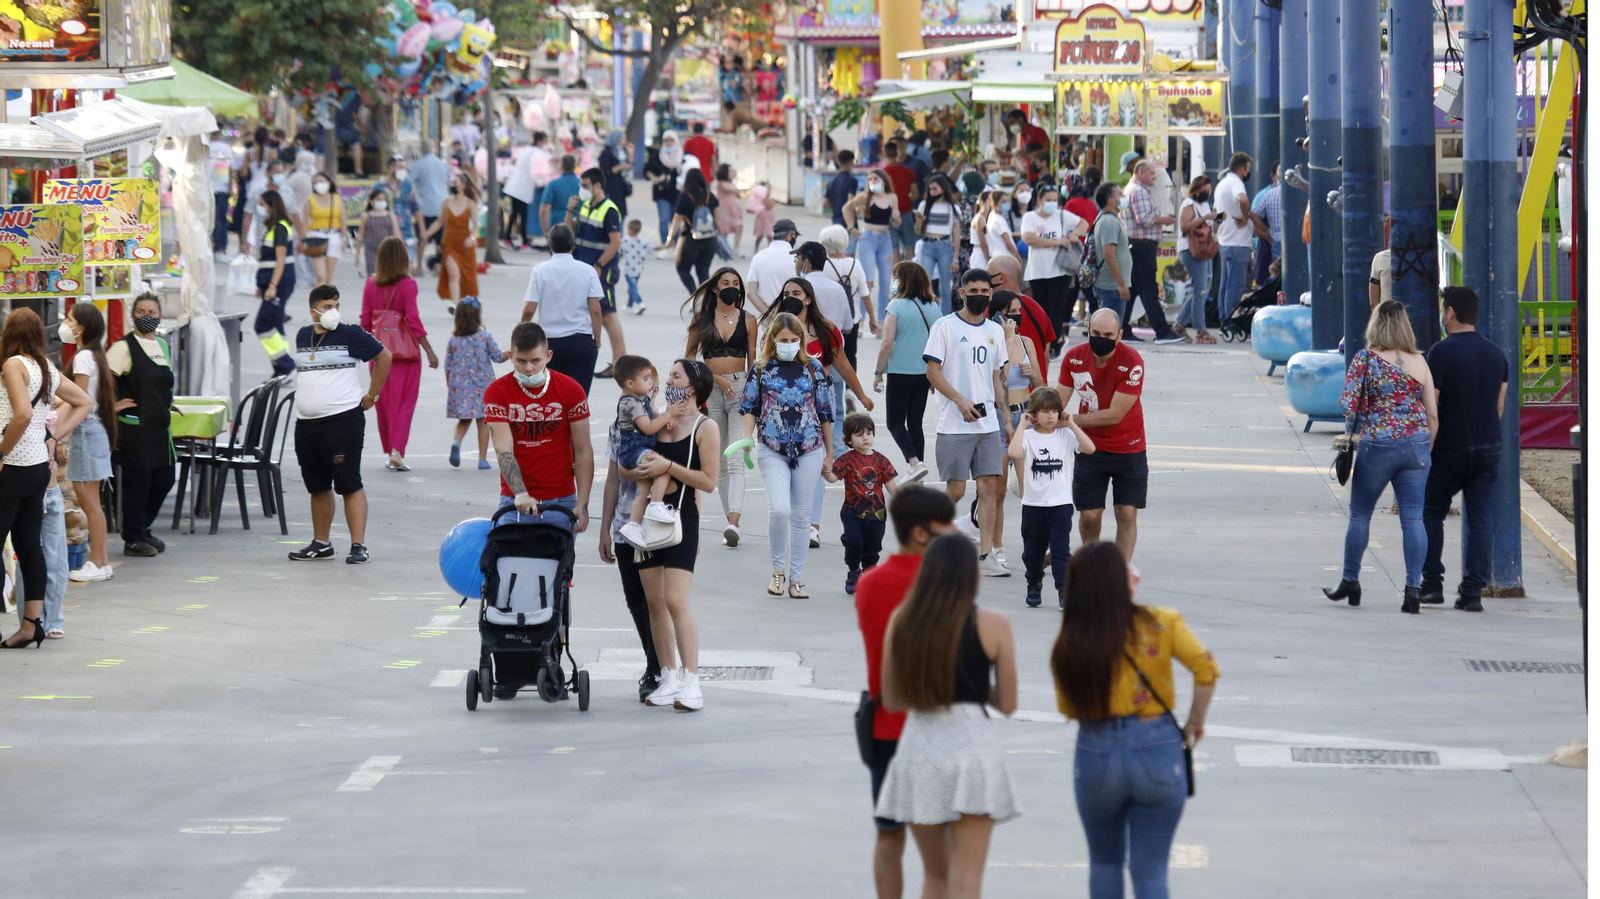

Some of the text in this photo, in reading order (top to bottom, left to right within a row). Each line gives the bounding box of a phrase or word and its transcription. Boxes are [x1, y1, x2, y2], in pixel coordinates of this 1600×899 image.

[9, 39, 54, 48] Normal
[1158, 85, 1213, 96] Buñuelos
[48, 182, 112, 200] MENÚ
[0, 208, 33, 228] NÚ
[972, 345, 987, 364] 10
[508, 402, 563, 422] DS2
